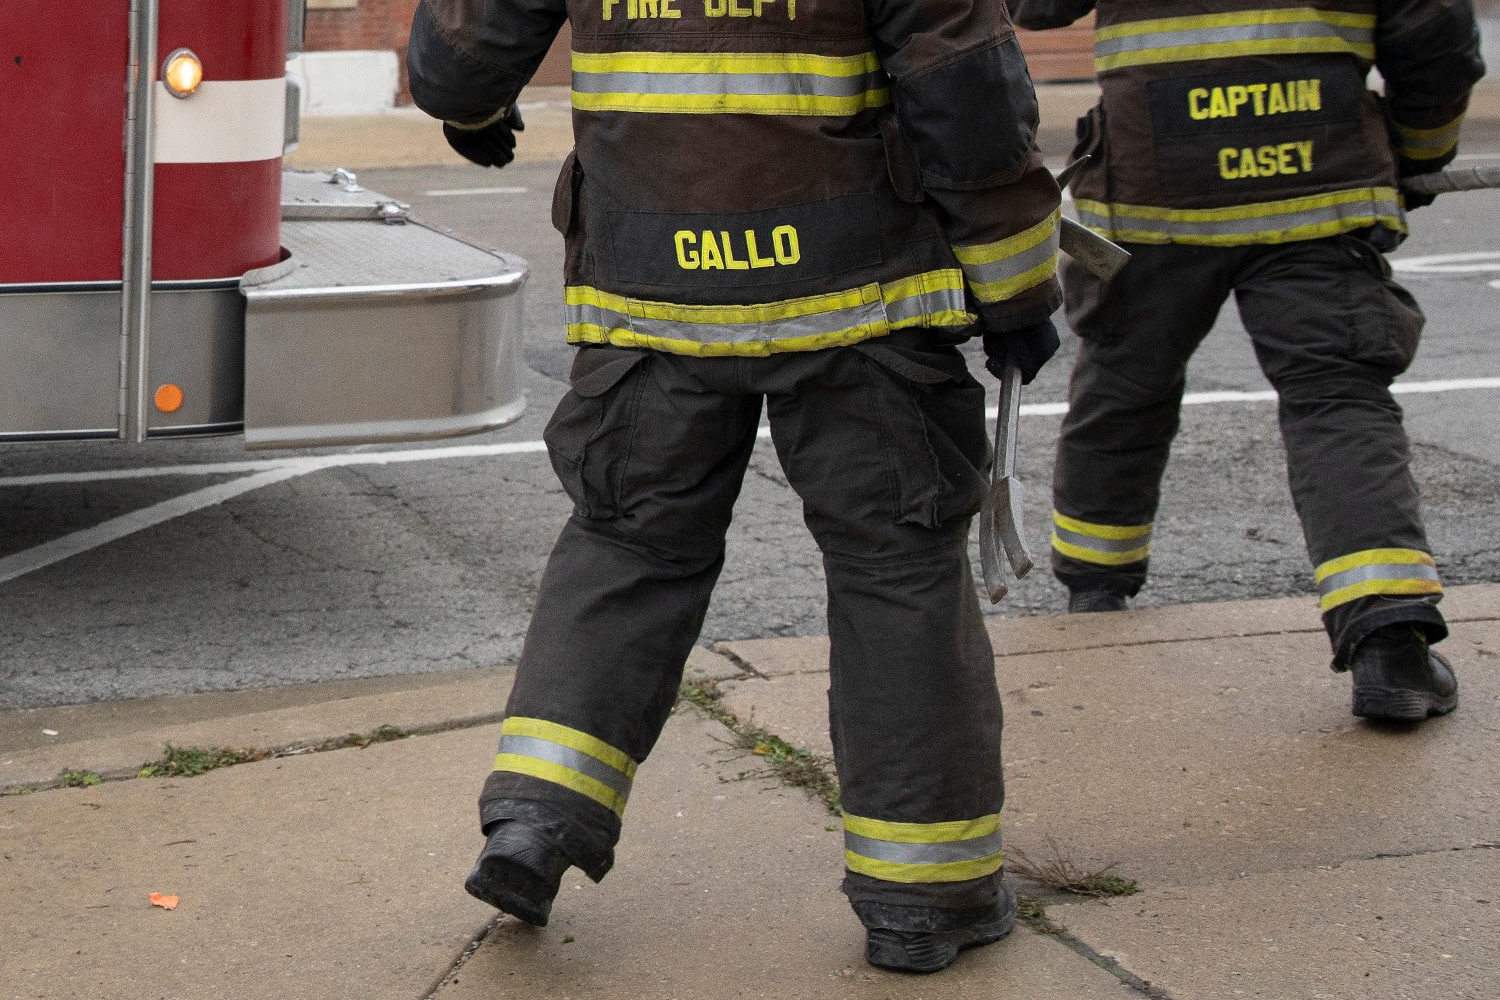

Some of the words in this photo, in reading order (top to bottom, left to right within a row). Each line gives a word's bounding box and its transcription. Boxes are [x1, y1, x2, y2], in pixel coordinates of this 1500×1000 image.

[1188, 79, 1322, 121] CAPTAIN
[1218, 140, 1314, 180] CASEY
[674, 224, 800, 270] GALLO
